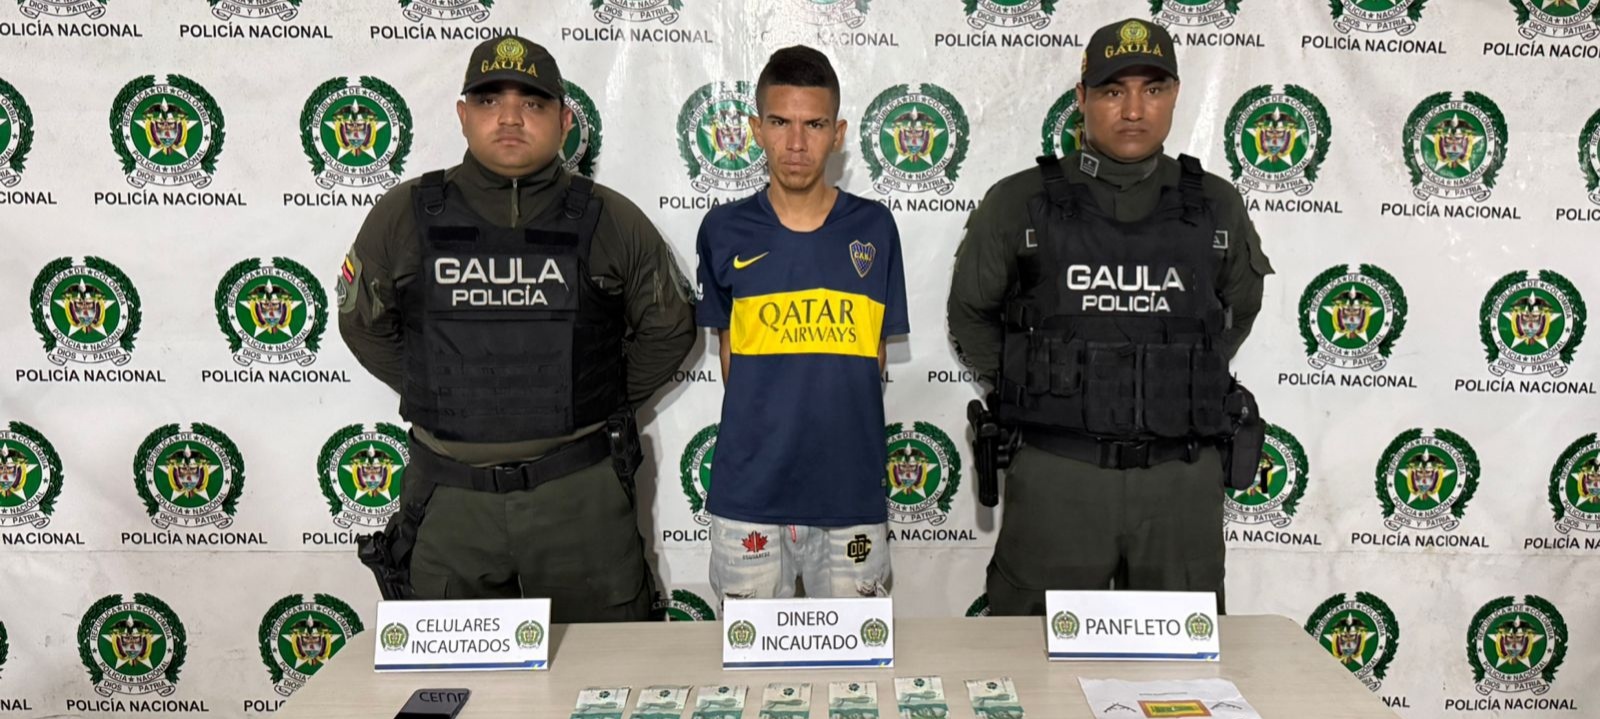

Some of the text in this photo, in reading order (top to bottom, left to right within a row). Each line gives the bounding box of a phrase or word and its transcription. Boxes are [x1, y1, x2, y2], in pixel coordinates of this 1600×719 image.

[58, 24, 142, 37] NACIONAL
[180, 22, 332, 38] POLICÍA NACIONAL
[370, 24, 436, 39] POLICÍA
[562, 25, 712, 43] POLICÍA NACIONAL
[935, 31, 1083, 47] POLICÍA NACIONAL
[1187, 33, 1264, 47] NACIONAL
[1302, 35, 1446, 54] POLICÍA NACIONAL
[1105, 43, 1163, 58] GAULA
[1484, 41, 1600, 58] POLICÍA NACIO
[481, 60, 538, 78] GAULA
[123, 90, 151, 127] REPUBLICA
[177, 90, 210, 126] COLOMBIA
[314, 91, 342, 128] REPUBLICA
[367, 91, 399, 127] COLOMBIA
[132, 149, 206, 173] POLICIA NACIONAL
[321, 150, 394, 174] POLICIA NACIONAL
[136, 170, 155, 181] DIOS
[173, 171, 202, 183] PATRIA
[325, 171, 344, 182] DIOS
[361, 172, 390, 184] PATRIA
[95, 190, 246, 205] POLICÍA NACIONAL
[284, 190, 347, 206] POLICÍA
[908, 199, 981, 212] NACIONA
[1265, 200, 1342, 213] NACIONAL
[1381, 202, 1520, 219] POLICÍA NACIONAL
[435, 257, 565, 285] GAULA
[1066, 264, 1186, 292] GAULA
[43, 271, 69, 306] REPUBLICA
[94, 271, 127, 306] COLOMBIA
[229, 272, 256, 308] REPUBLICA
[281, 272, 314, 306] COLOMBIA
[452, 284, 549, 306] POLICÍA
[1082, 292, 1171, 312] POLICÍA
[758, 298, 855, 332] QATAR
[52, 328, 124, 350] POLICIA NACIONAL
[238, 329, 310, 351] POLICIA NACIONAL
[780, 326, 857, 344] AIRWAYS
[57, 347, 76, 359] DIOS
[93, 349, 121, 360] PATRIA
[242, 348, 261, 360] DIOS
[278, 350, 306, 361] PATRIA
[16, 367, 165, 382] POLICÍA NACIONAL
[202, 368, 350, 382] POLICÍA NACIONAL
[1278, 371, 1416, 388] POLICÍA NACIONAL
[1455, 378, 1596, 394] POLICÍA NACIONAL
[147, 437, 174, 472] REPUBLICA
[199, 437, 231, 471] COLOMBIA
[155, 492, 227, 515] POLICIA NACIONAL
[159, 512, 178, 523] DIOS
[195, 513, 223, 524] PATRIA
[2, 533, 84, 544] NACIONAL
[122, 530, 267, 544] POLICÍA NACIONAL
[663, 528, 710, 542] POLICÍ
[901, 530, 976, 540] NACIONAL
[1243, 530, 1321, 545] NACIONAL
[1352, 532, 1488, 548] POLICÍA NACIONAL
[1524, 535, 1580, 549] POLICÍA
[415, 618, 500, 632] CELULARES
[777, 610, 839, 626] DINERO
[1086, 618, 1181, 636] PANFLETO
[411, 638, 510, 654] INCAUTADOS
[762, 634, 858, 650] INCAUTADO
[67, 698, 209, 712] POLICÍA NACIONAL
[244, 700, 286, 712] POLI
[1445, 696, 1577, 710] POLICÍA NACIONAL
